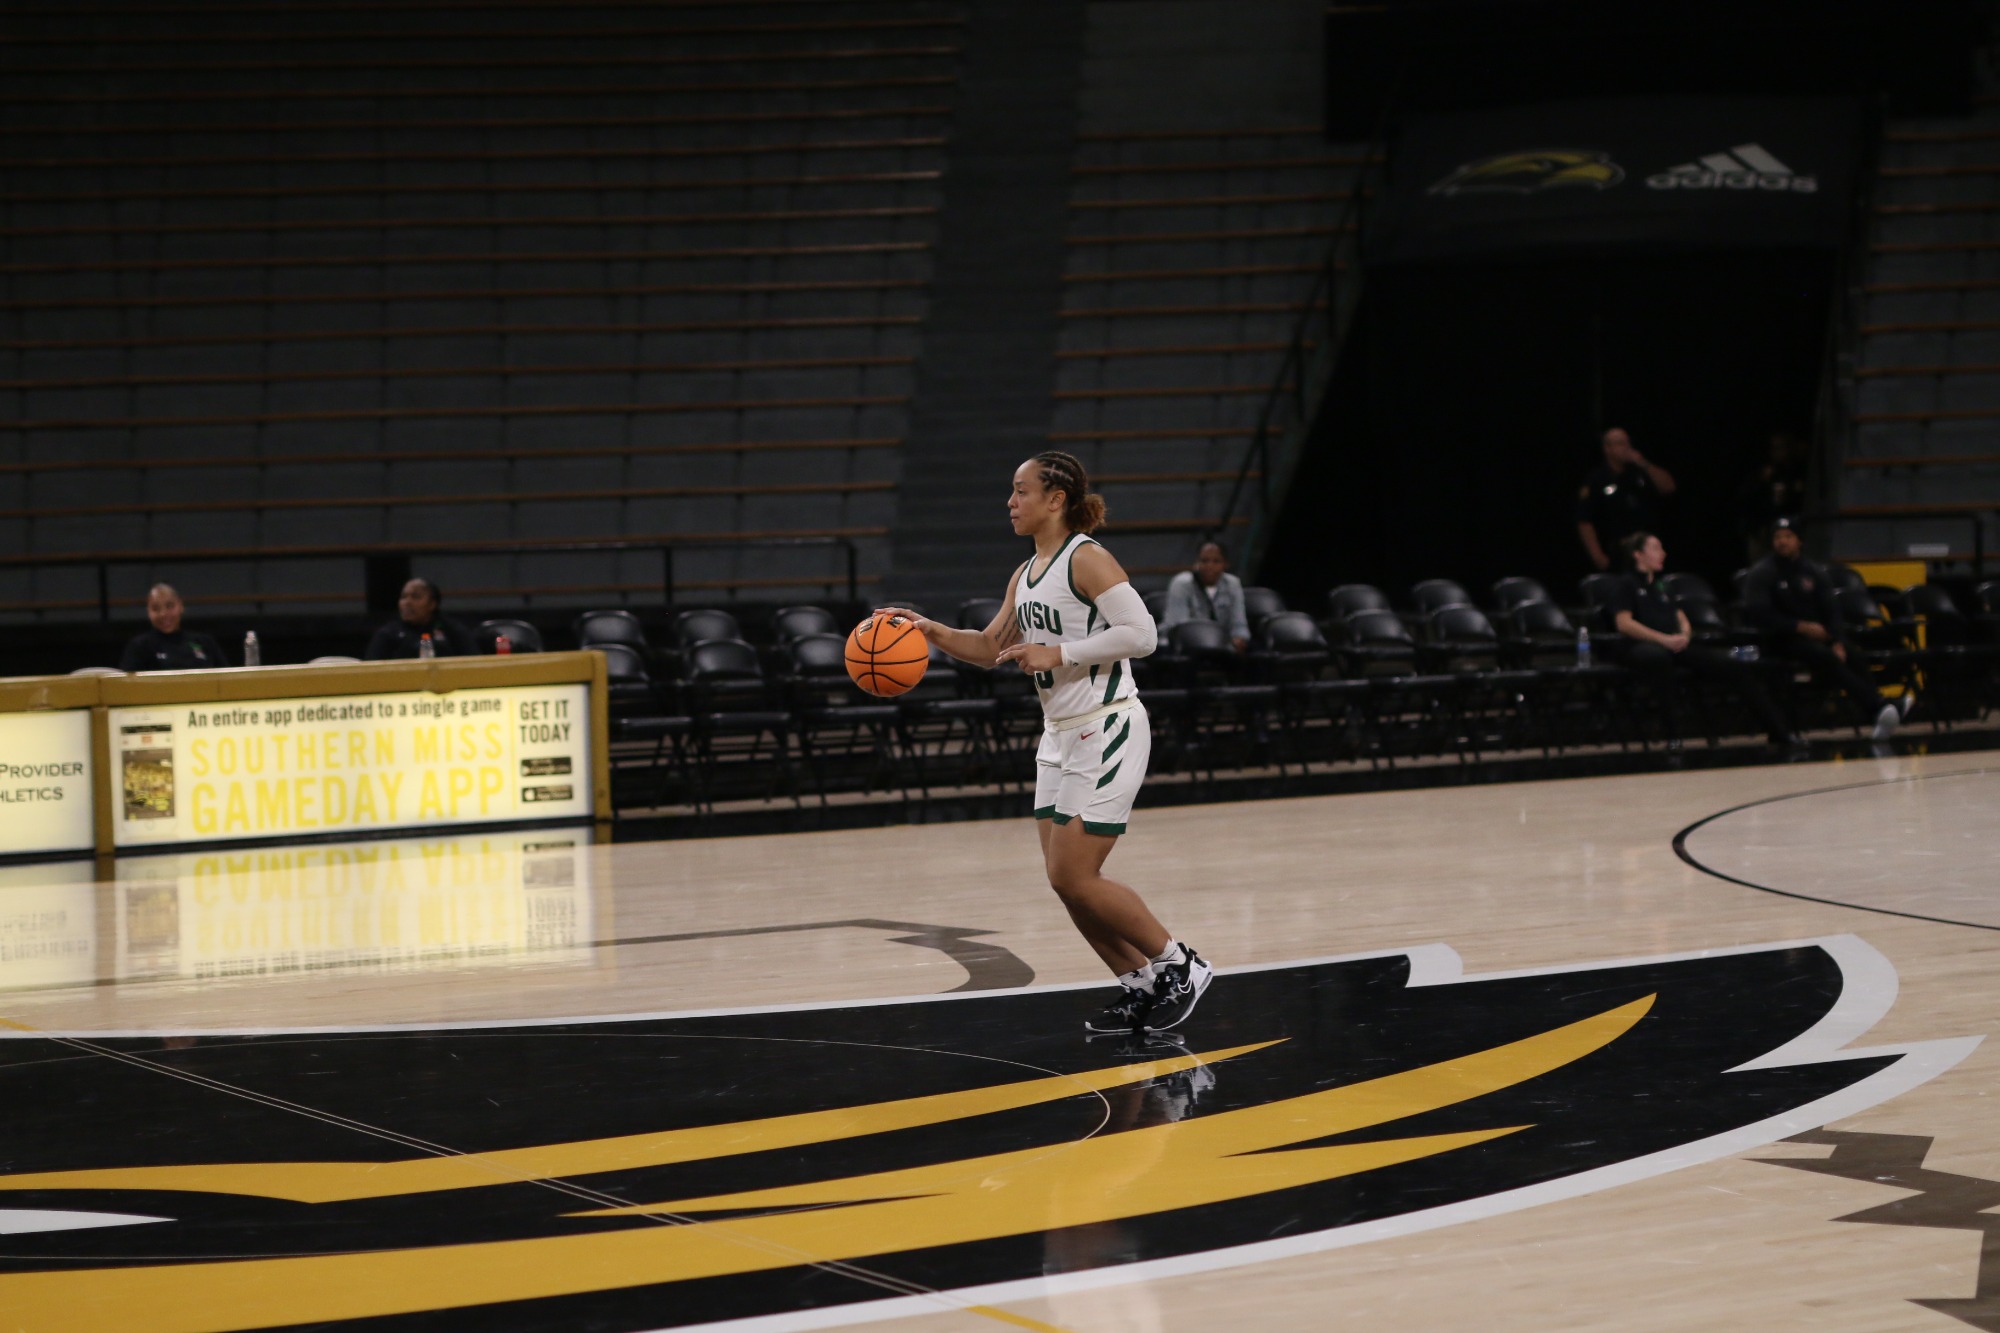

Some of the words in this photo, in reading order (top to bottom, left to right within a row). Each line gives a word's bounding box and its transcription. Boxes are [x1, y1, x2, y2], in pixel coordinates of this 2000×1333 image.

[1646, 170, 1818, 193] adidas
[188, 711, 207, 728] An
[212, 707, 259, 726] entire
[265, 709, 292, 726] app
[297, 702, 373, 723] dedicated
[379, 702, 393, 717] to
[400, 703, 407, 716] a
[412, 698, 455, 719] single
[461, 699, 502, 716] game
[520, 701, 550, 721] GET
[555, 700, 570, 718] IT
[520, 723, 571, 743] TODAY
[192, 731, 394, 776] SOUTHERN
[414, 723, 502, 763] MISS
[191, 772, 404, 834] GAMEDAY
[420, 767, 503, 820] APP
